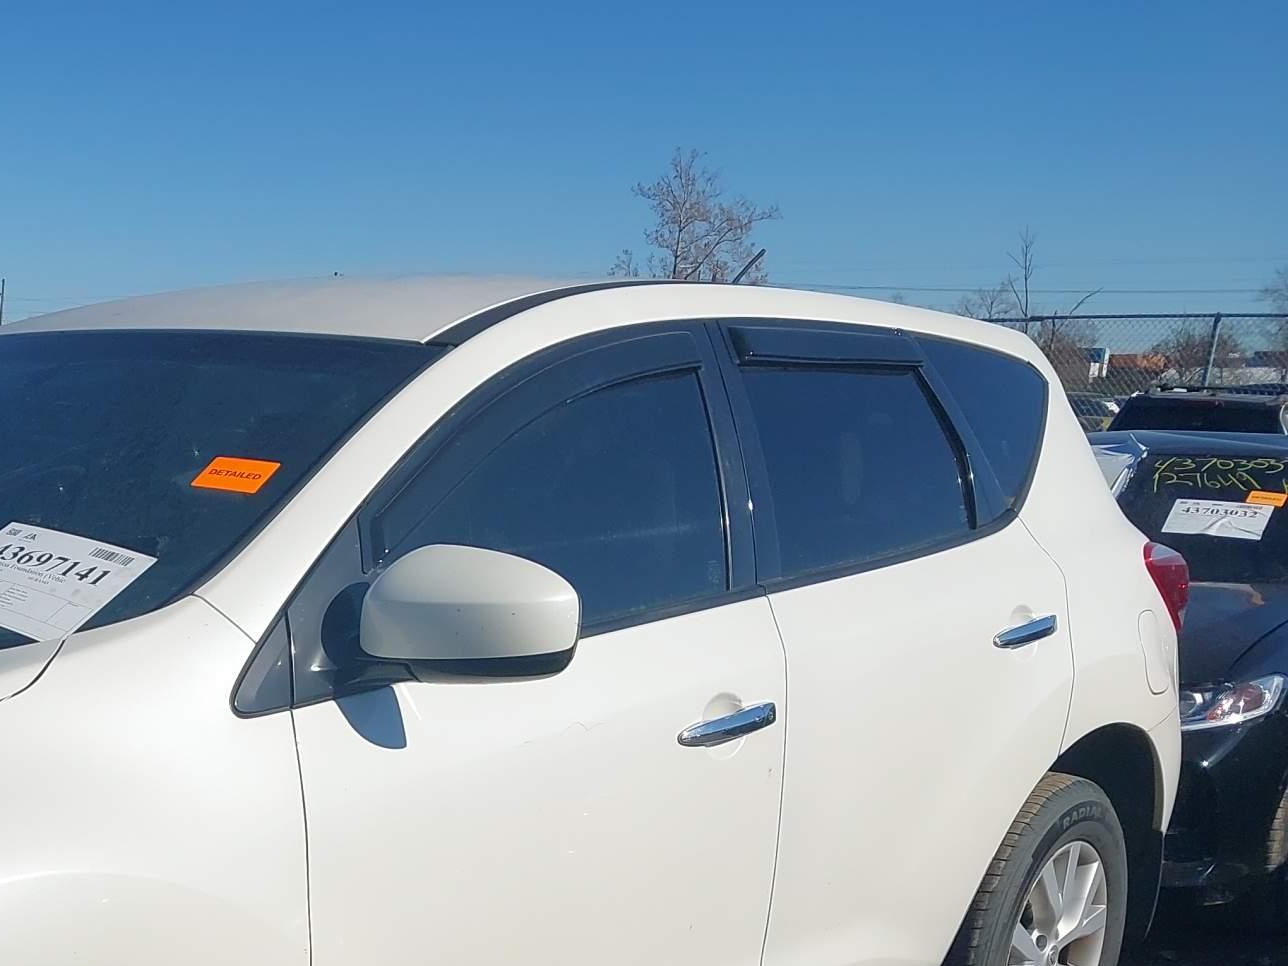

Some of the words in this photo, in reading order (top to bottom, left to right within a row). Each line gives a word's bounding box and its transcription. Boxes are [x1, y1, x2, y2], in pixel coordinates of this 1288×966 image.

[1153, 456, 1288, 476] 4370303
[207, 468, 263, 480] DETAILED
[1181, 506, 1259, 518] 43703032
